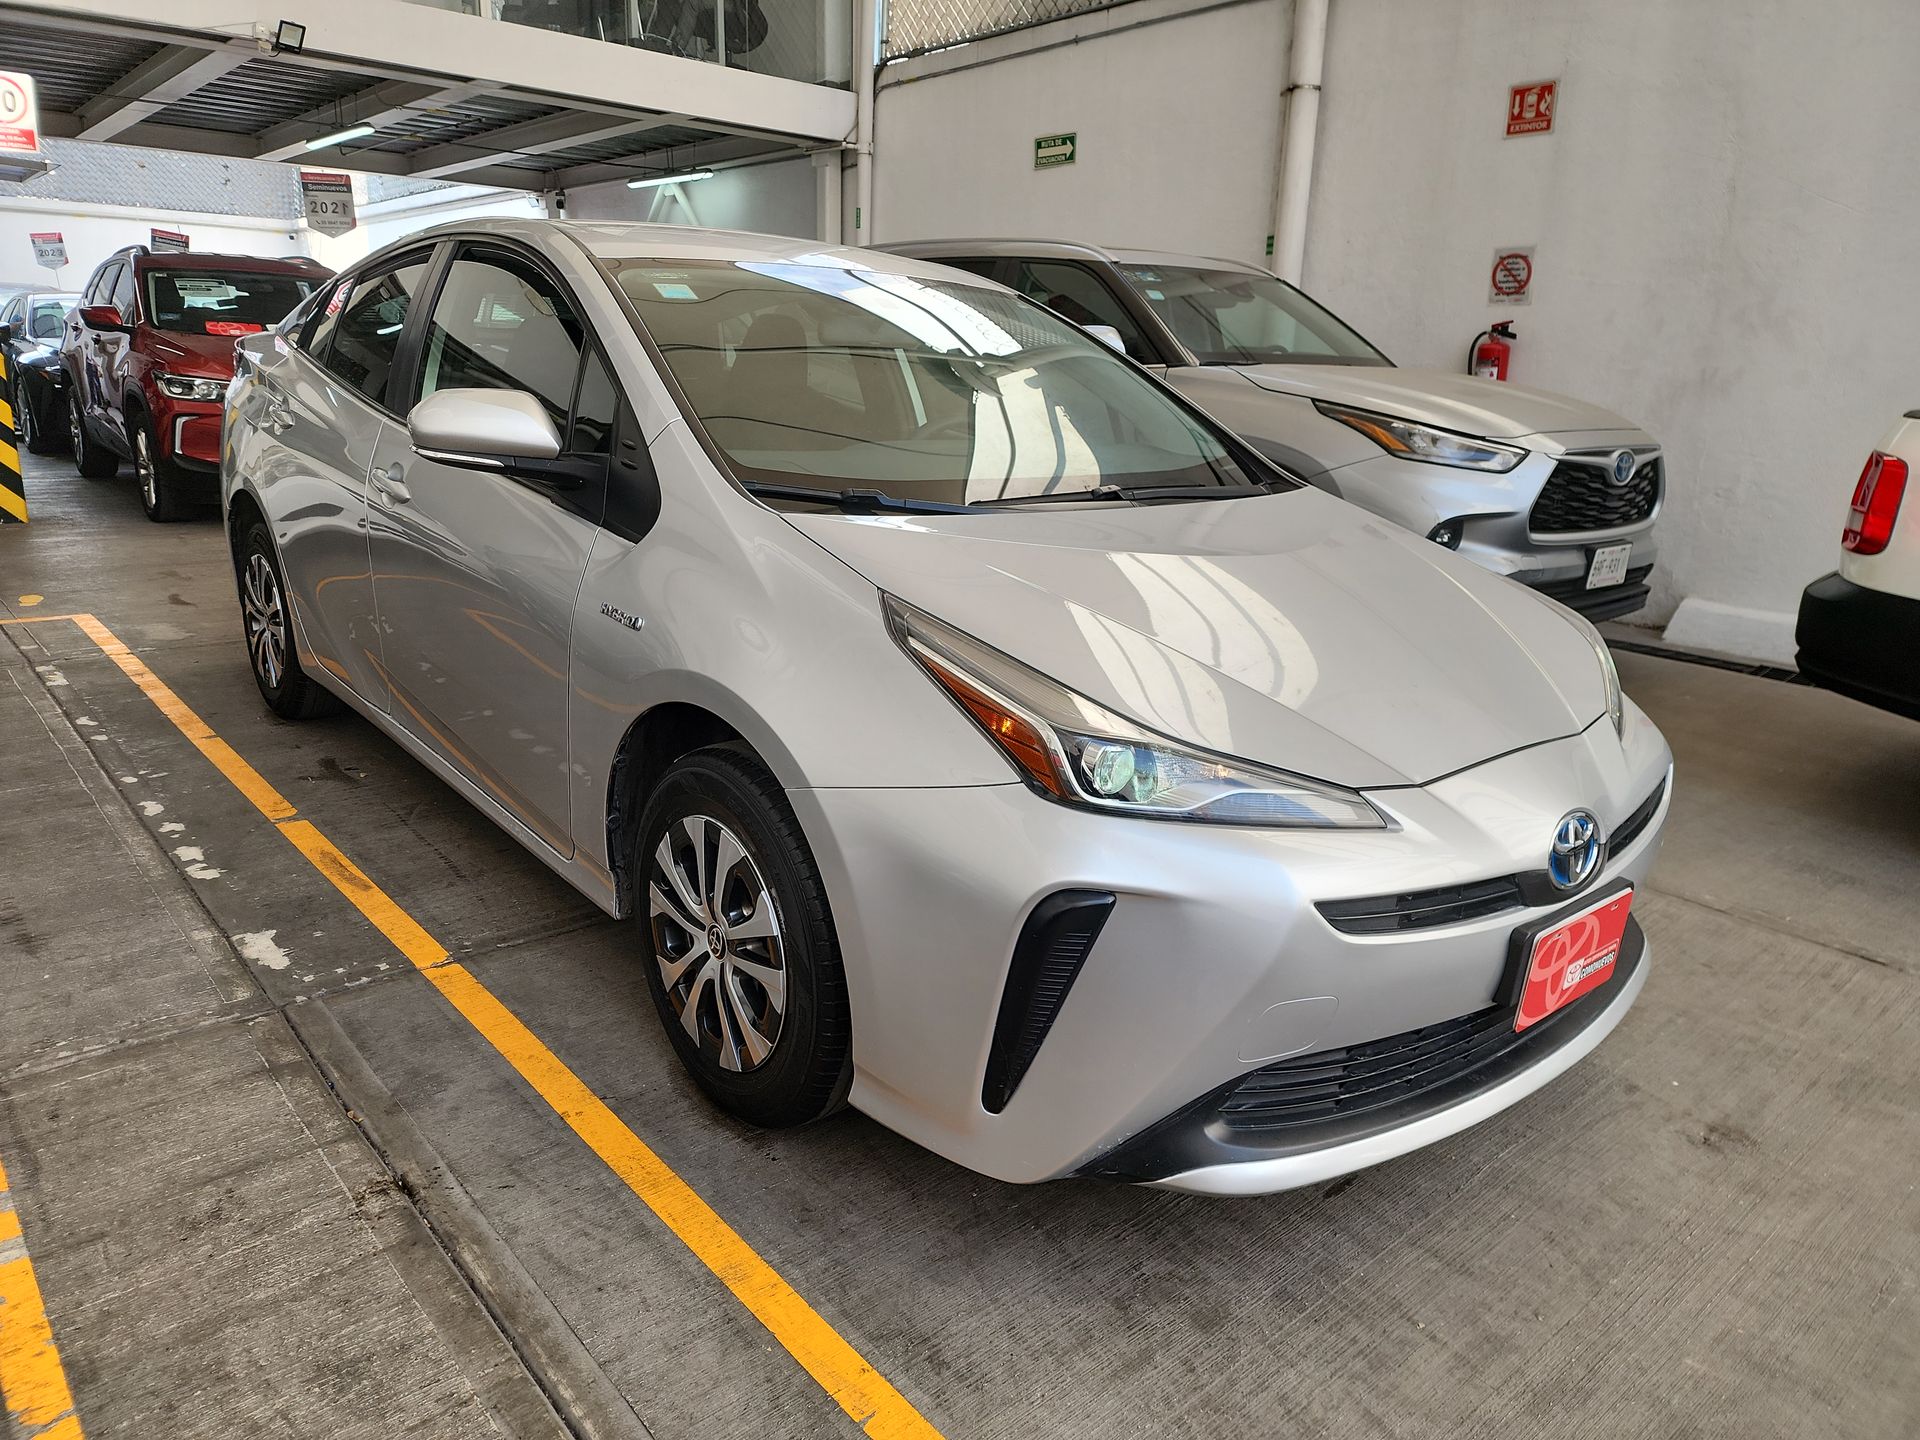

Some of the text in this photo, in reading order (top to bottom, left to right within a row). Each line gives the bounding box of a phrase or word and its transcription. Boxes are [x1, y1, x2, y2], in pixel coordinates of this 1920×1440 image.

[1510, 121, 1548, 132] EXTINTOR
[1041, 140, 1055, 148] RUTA
[307, 183, 348, 192] Seminuevos
[310, 200, 350, 215] 2021
